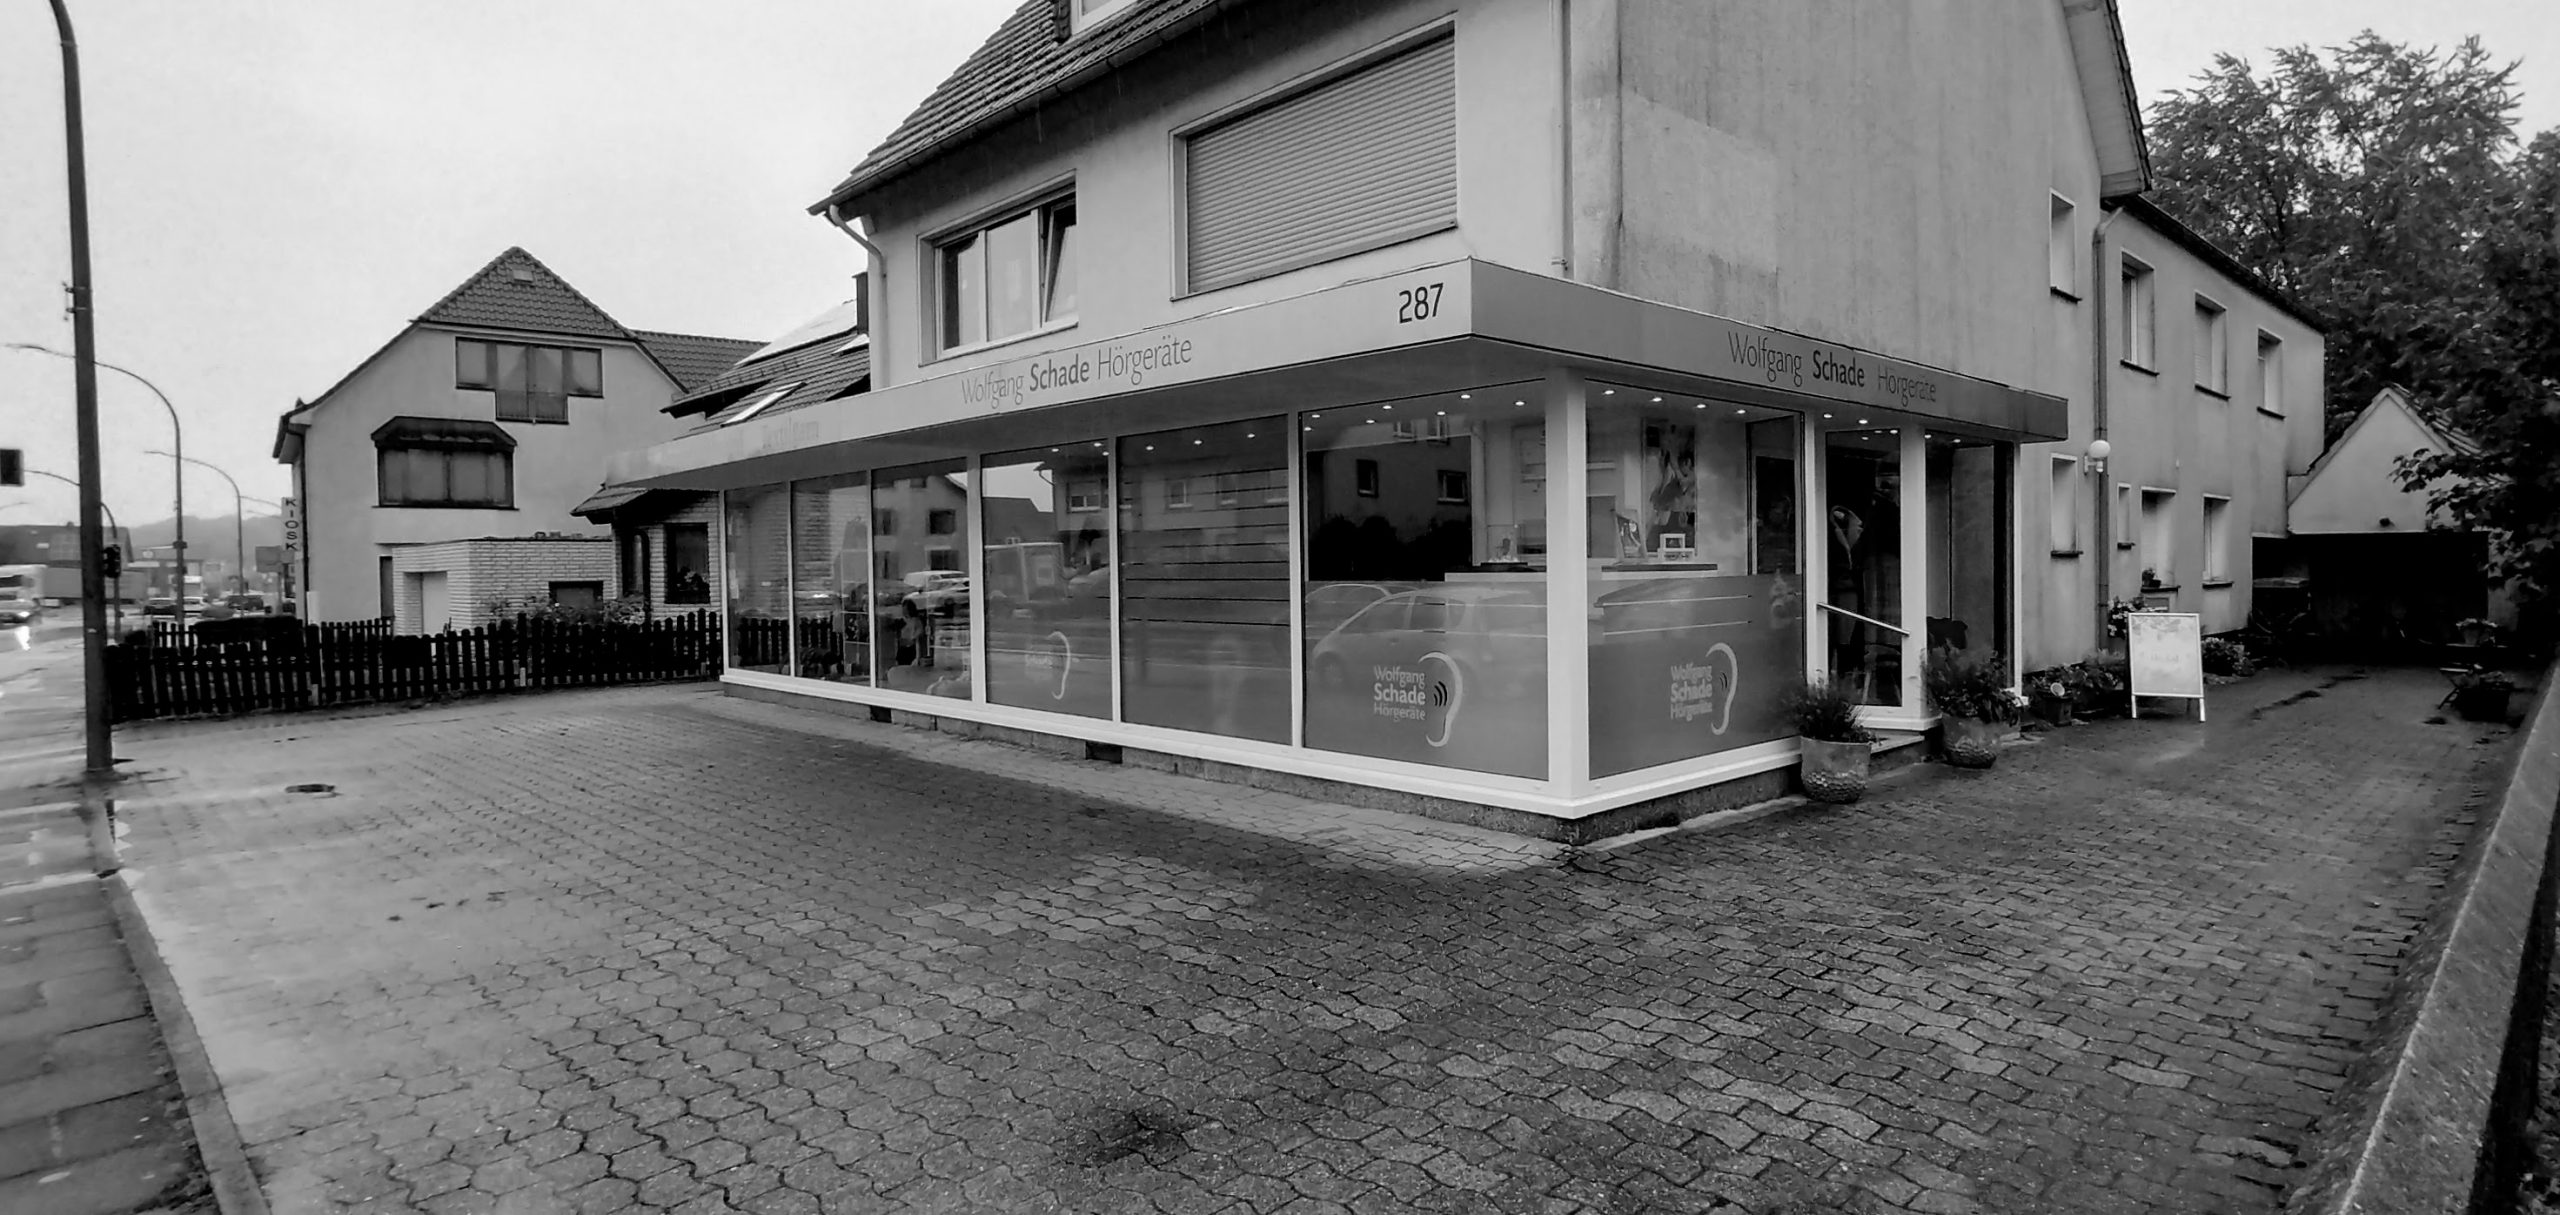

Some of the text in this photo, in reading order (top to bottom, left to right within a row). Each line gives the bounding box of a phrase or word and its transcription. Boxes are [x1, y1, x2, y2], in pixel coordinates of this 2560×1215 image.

[1399, 282, 1443, 324] 287
[961, 335, 1193, 409] Wolfgang Schade Hörgeräte
[1727, 330, 1803, 388] Wolfgang
[1812, 349, 1865, 388] Schade
[285, 498, 299, 552] KIOSK
[1373, 682, 1426, 705] Schade
[1374, 665, 1425, 689] Wolfgang
[1373, 701, 1426, 722] Hörgeräte
